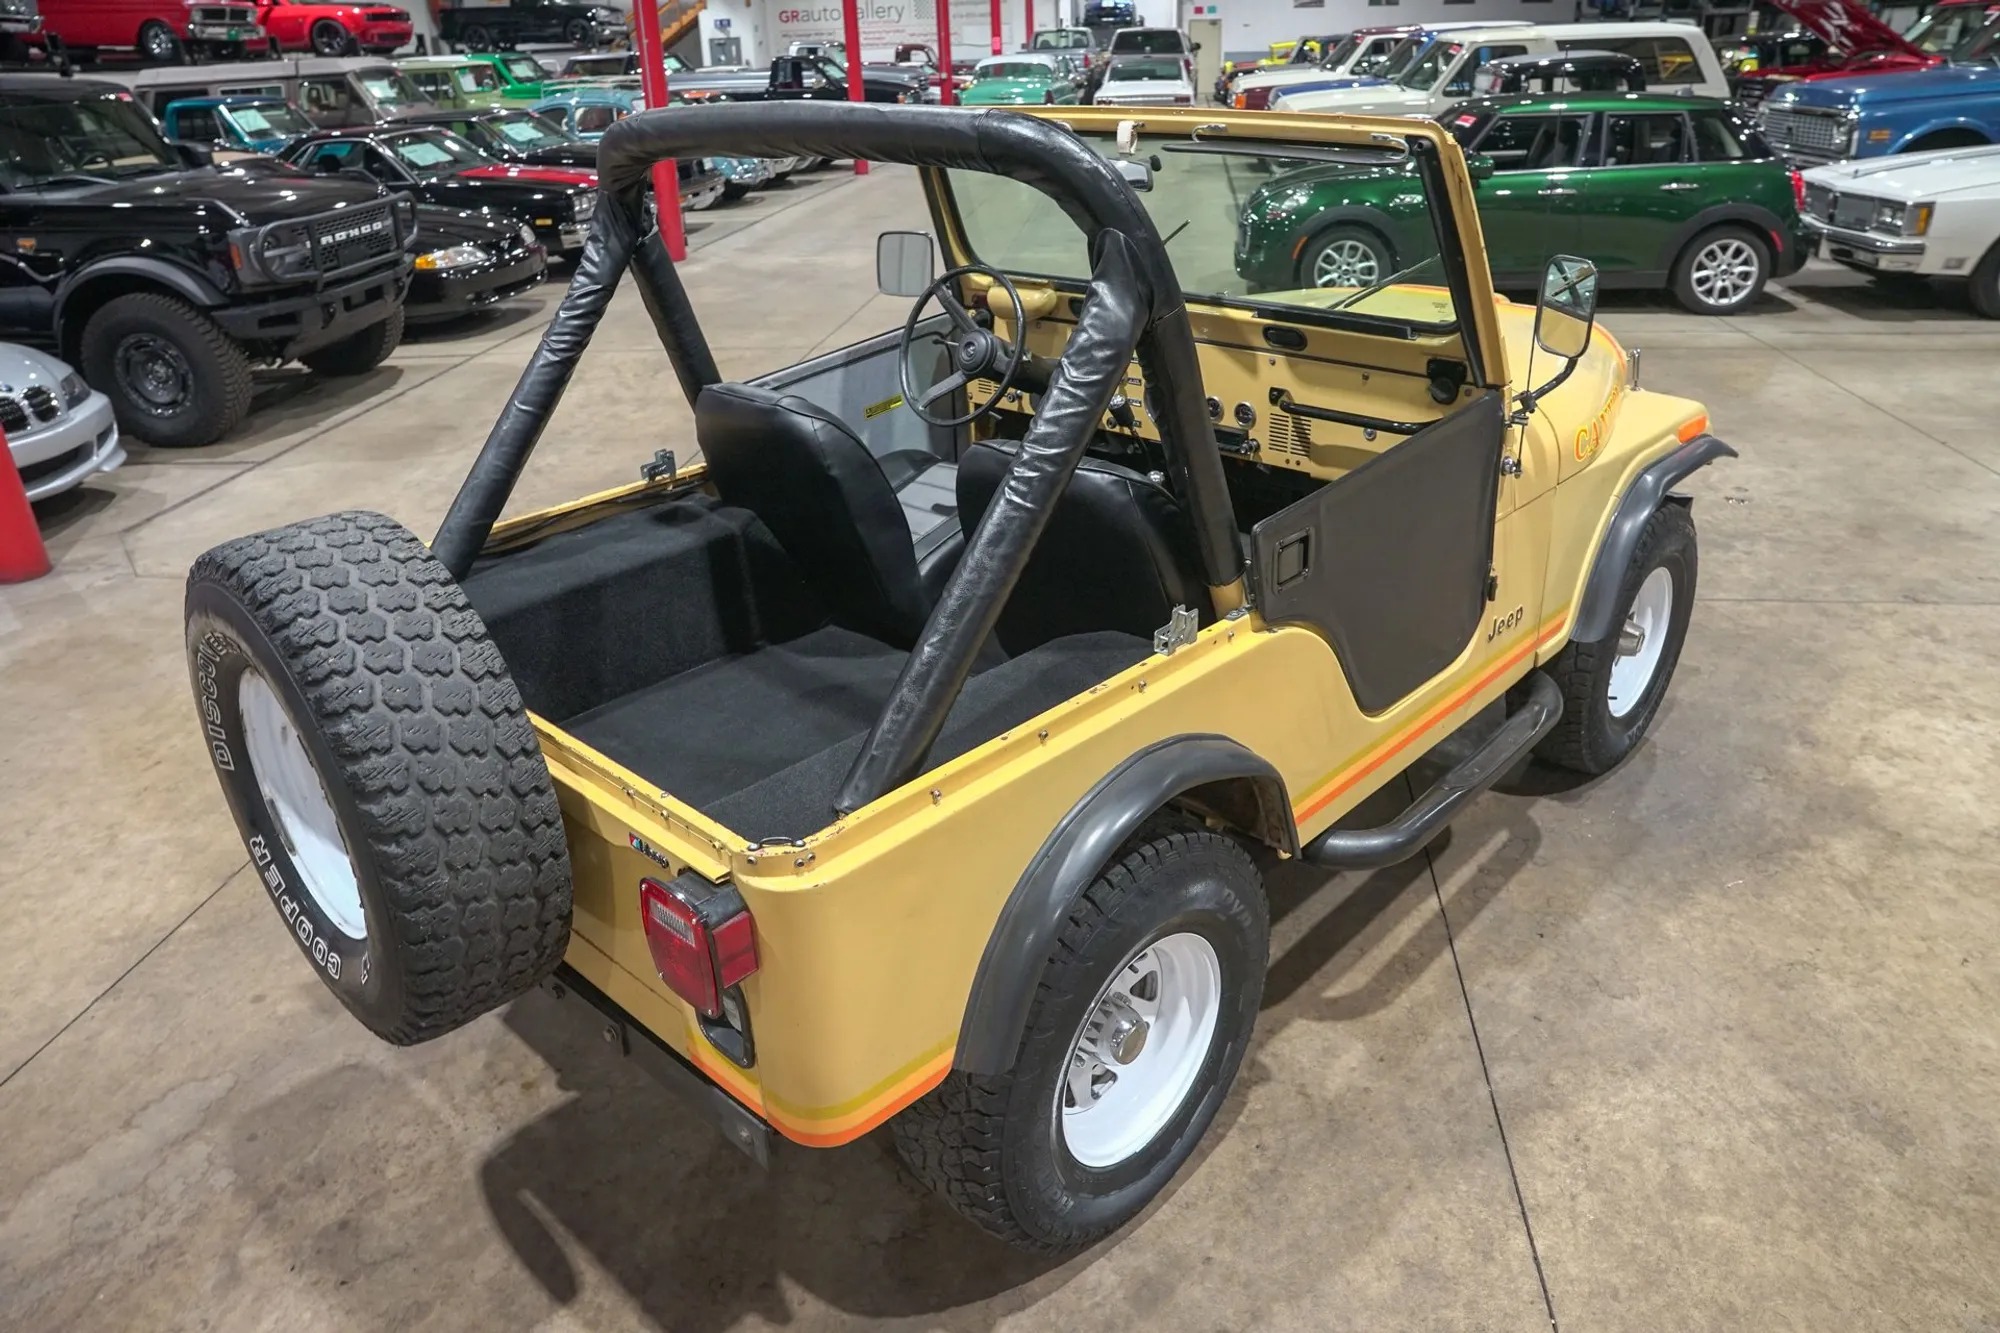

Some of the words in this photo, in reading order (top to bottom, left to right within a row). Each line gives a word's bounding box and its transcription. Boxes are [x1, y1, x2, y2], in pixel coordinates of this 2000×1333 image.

[778, 0, 904, 24] GRautoallery
[305, 221, 382, 248] RONCO
[1487, 604, 1524, 643] Jeep
[250, 834, 341, 979] COOPER
